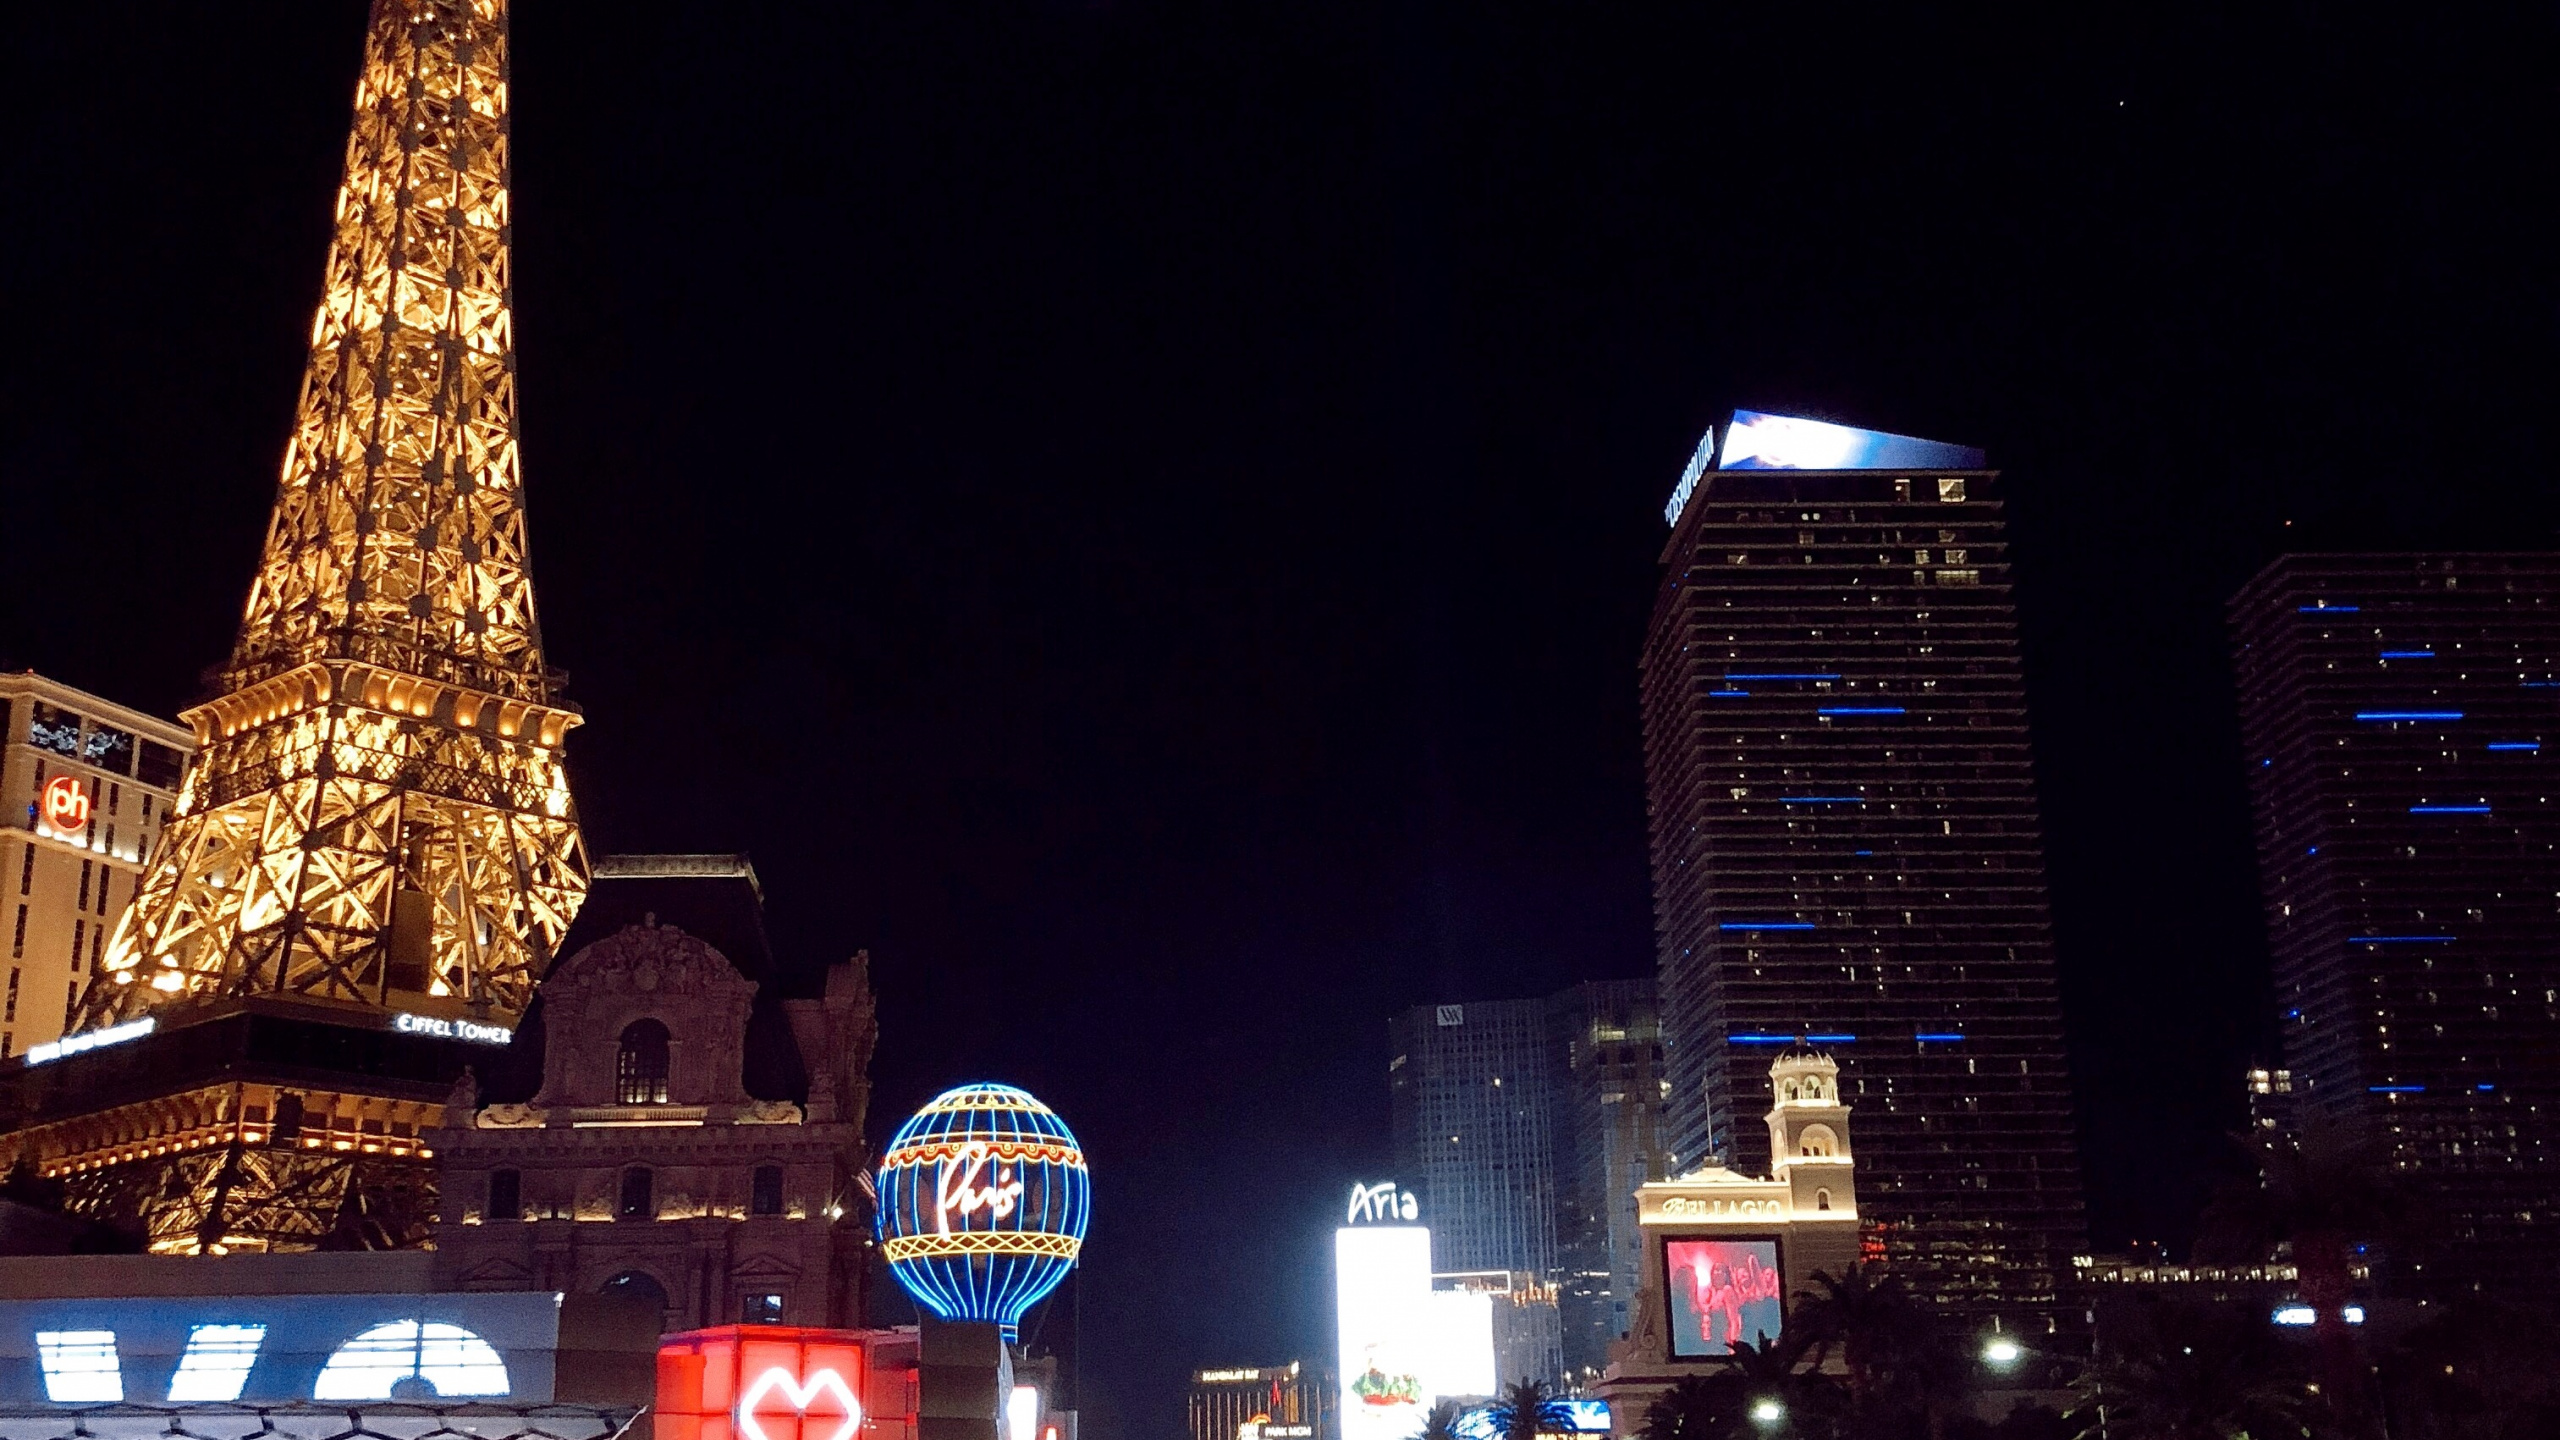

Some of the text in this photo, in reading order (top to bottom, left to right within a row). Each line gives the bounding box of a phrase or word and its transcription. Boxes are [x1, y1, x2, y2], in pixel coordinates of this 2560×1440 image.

[51, 780, 89, 819] ph
[397, 1013, 512, 1044] EIFFEL TOWER
[937, 1141, 1023, 1242] Paris
[1347, 1182, 1419, 1224] Aria
[1662, 1197, 1781, 1217] BELLAGIO
[1264, 1426, 1287, 1438] PARK
[1288, 1425, 1312, 1437] MGM
